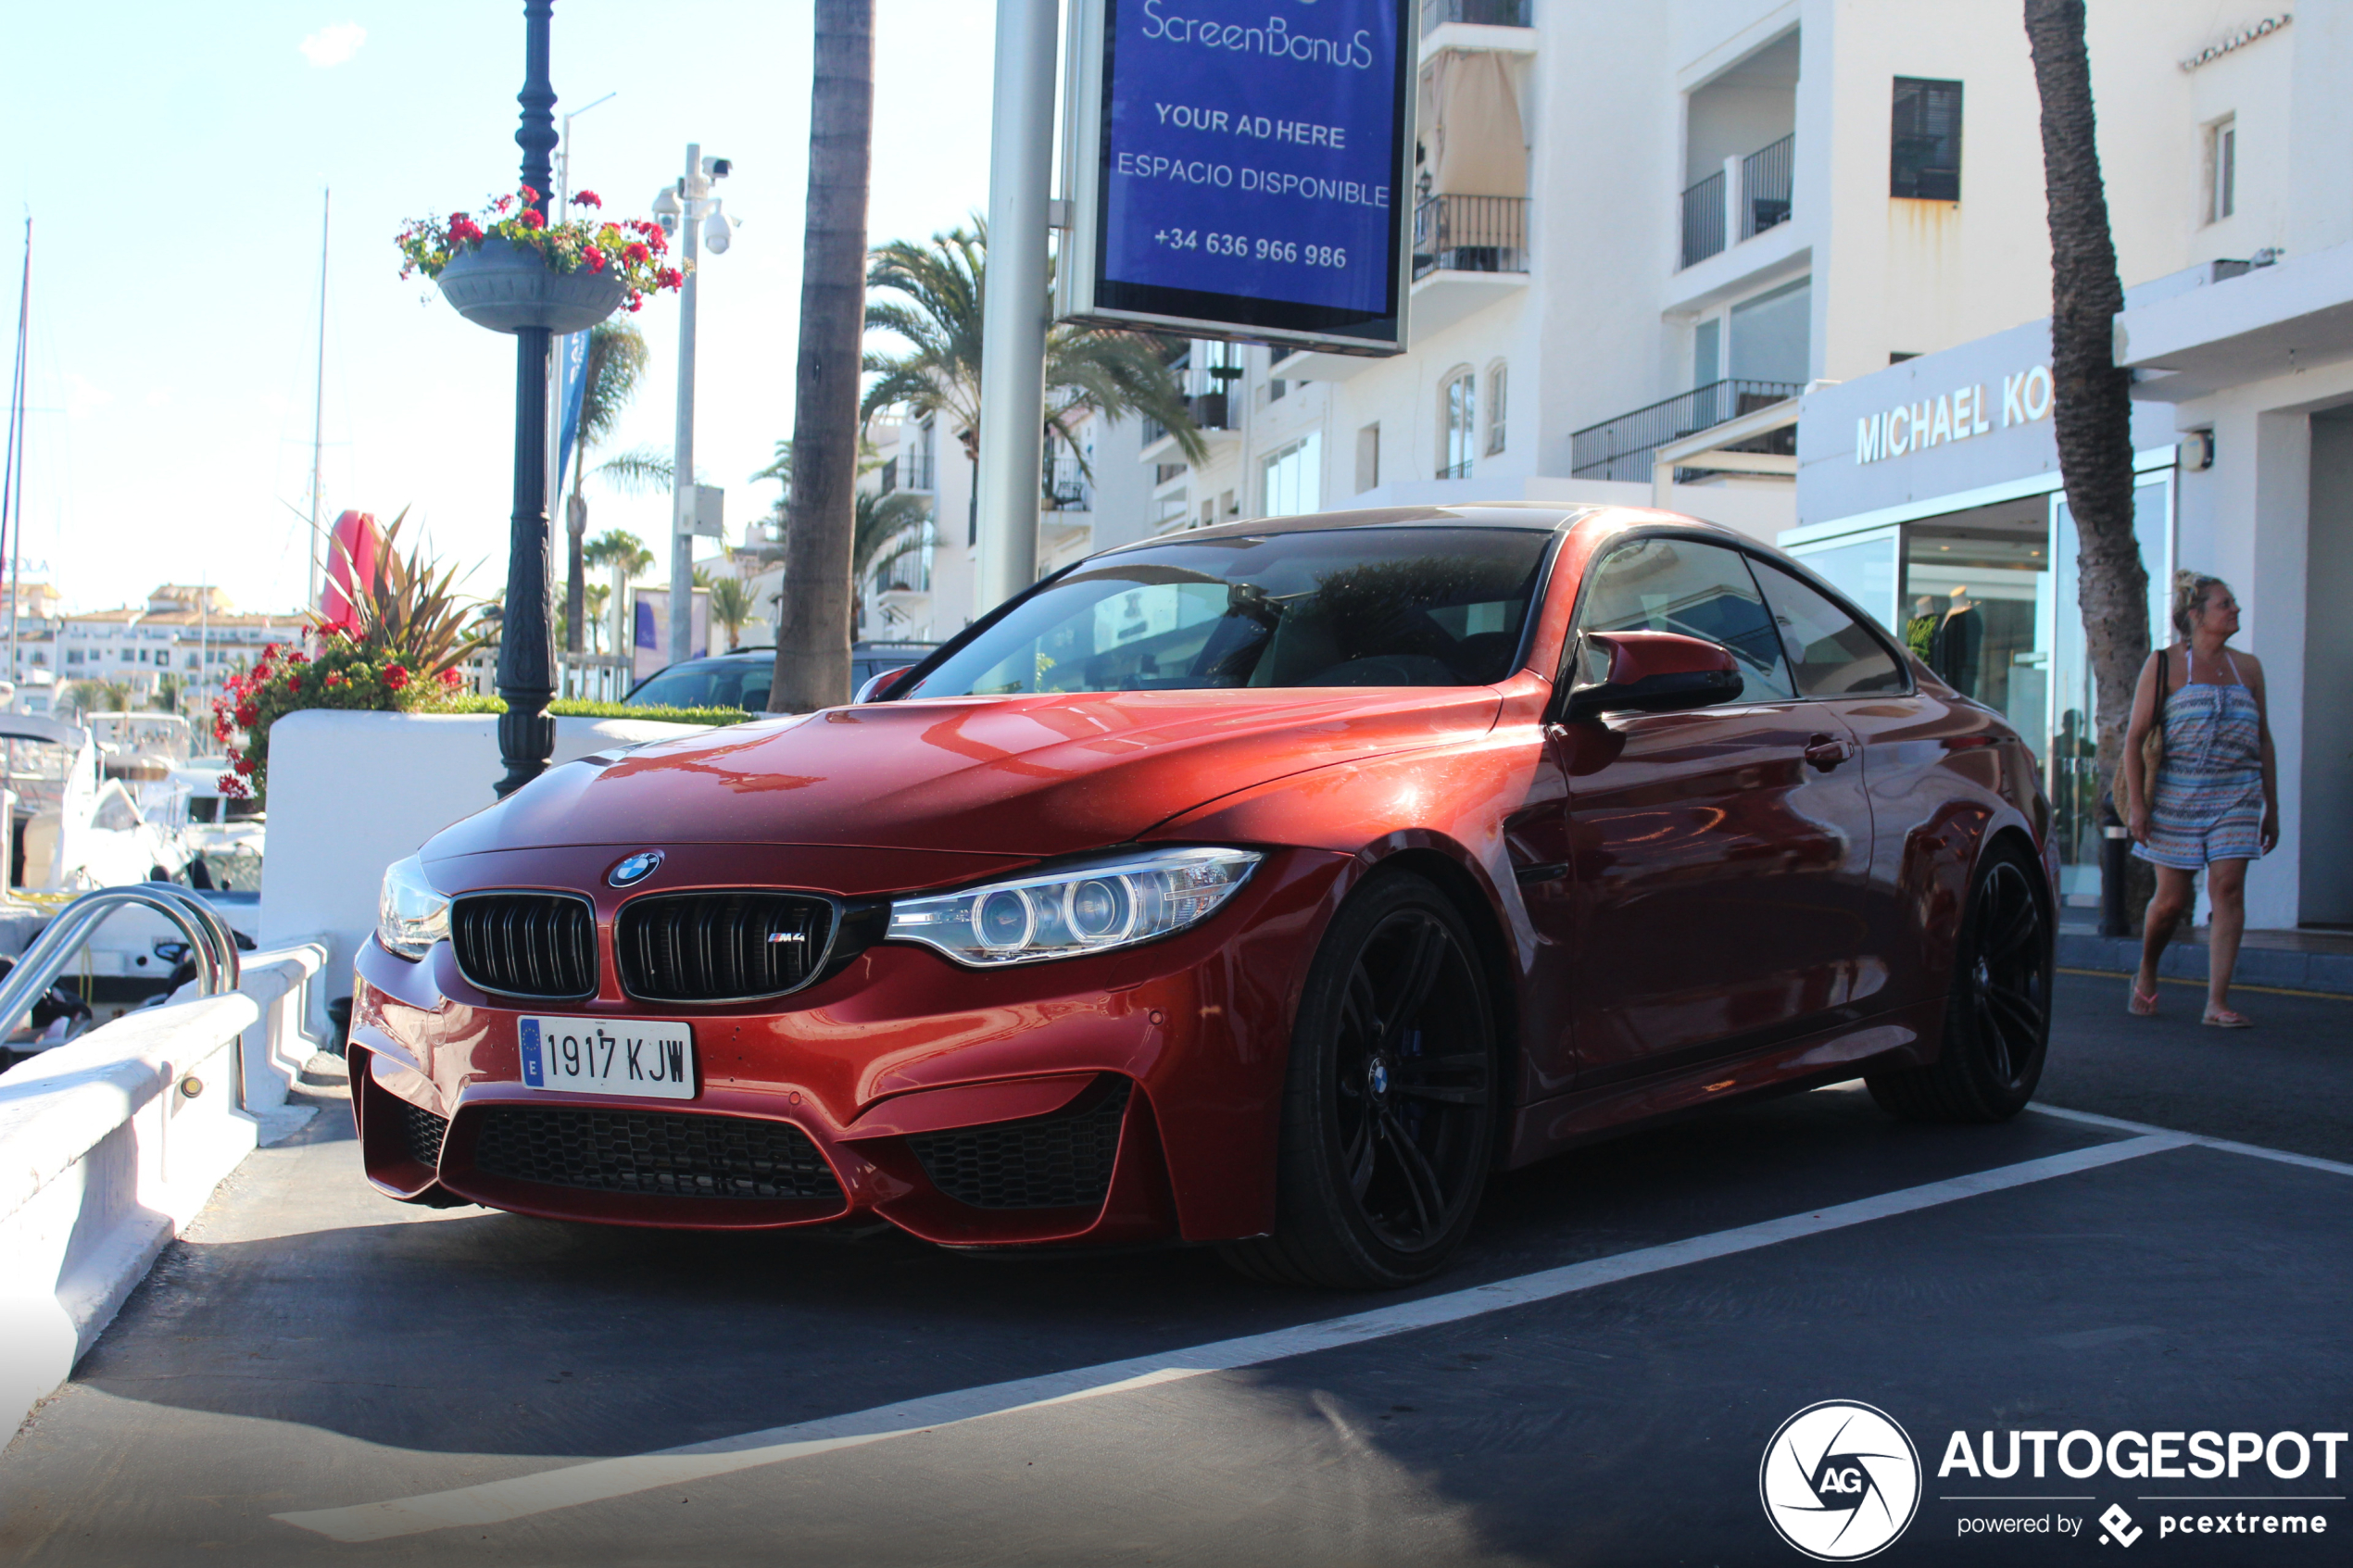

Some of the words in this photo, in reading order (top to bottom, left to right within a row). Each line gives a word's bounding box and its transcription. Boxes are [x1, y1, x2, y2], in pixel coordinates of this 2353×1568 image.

[1155, 102, 1229, 132] YOUR
[1236, 115, 1272, 139] AD
[1277, 119, 1346, 149] HERE
[1117, 152, 1233, 187] ESPACIO
[1240, 168, 1390, 208] DISPONIBLE
[1154, 228, 1198, 251] +34
[1206, 232, 1249, 257] 636
[1255, 238, 1298, 263] 966
[1304, 245, 1347, 269] 986
[1856, 383, 1990, 466] MICHAEL
[2002, 364, 2057, 428] KO
[778, 932, 806, 943] M4
[528, 1060, 537, 1075] E
[547, 1034, 616, 1079] 1917
[626, 1037, 684, 1083] KJW
